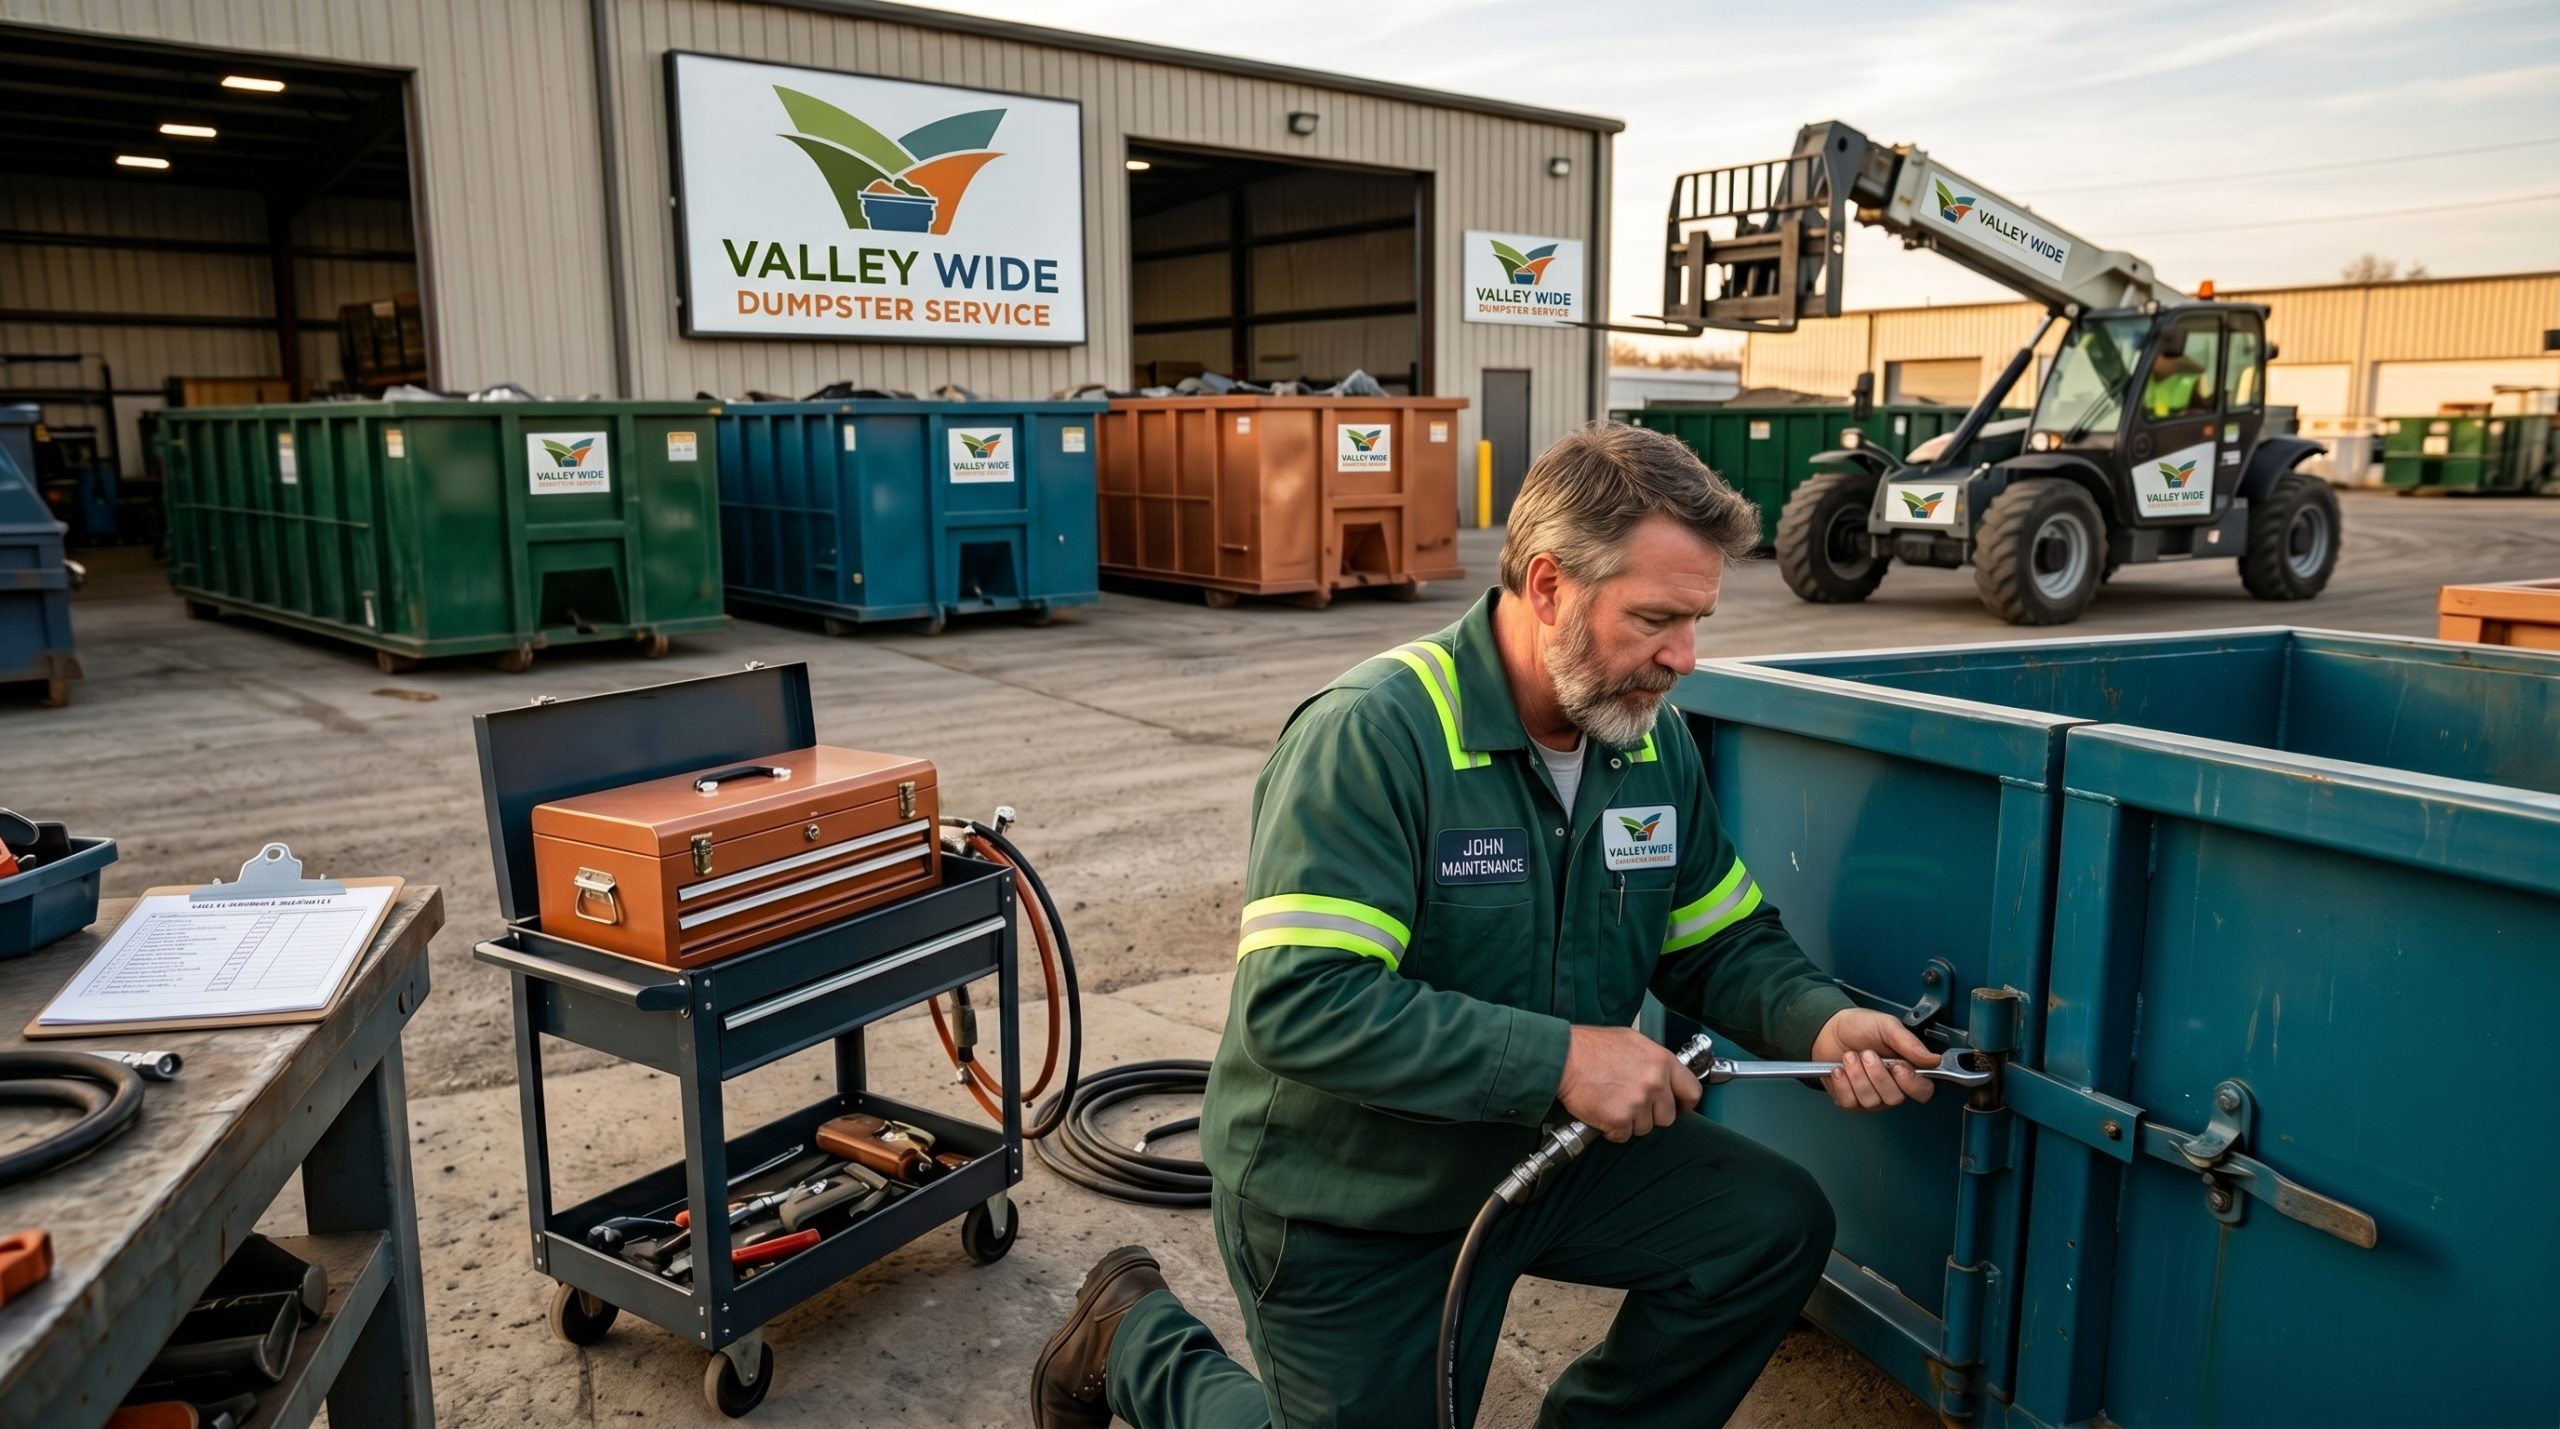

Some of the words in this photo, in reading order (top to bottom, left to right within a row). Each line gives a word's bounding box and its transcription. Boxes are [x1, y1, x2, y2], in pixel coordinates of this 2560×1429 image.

[1979, 209, 2028, 245] VALLEY
[2030, 235, 2064, 264] WIDE
[722, 239, 919, 286] VALLEY
[933, 252, 1059, 294] WIDE
[1476, 287, 1531, 303] VALLEY
[1535, 291, 1571, 306] WIDE
[737, 289, 914, 321] DUMPSTER
[925, 299, 1051, 327] SERVICE
[1479, 304, 1529, 315] DUMPSTER
[1532, 307, 1569, 317] SERVICE
[536, 471, 575, 481] VALLEY
[577, 470, 604, 480] WIDE
[2146, 492, 2180, 503] VALLEY
[1463, 837, 1504, 857] JOHN
[1609, 845, 1647, 858] VALLEY
[1648, 843, 1674, 855] WIDE
[1441, 858, 1524, 877] MAINTENANCE
